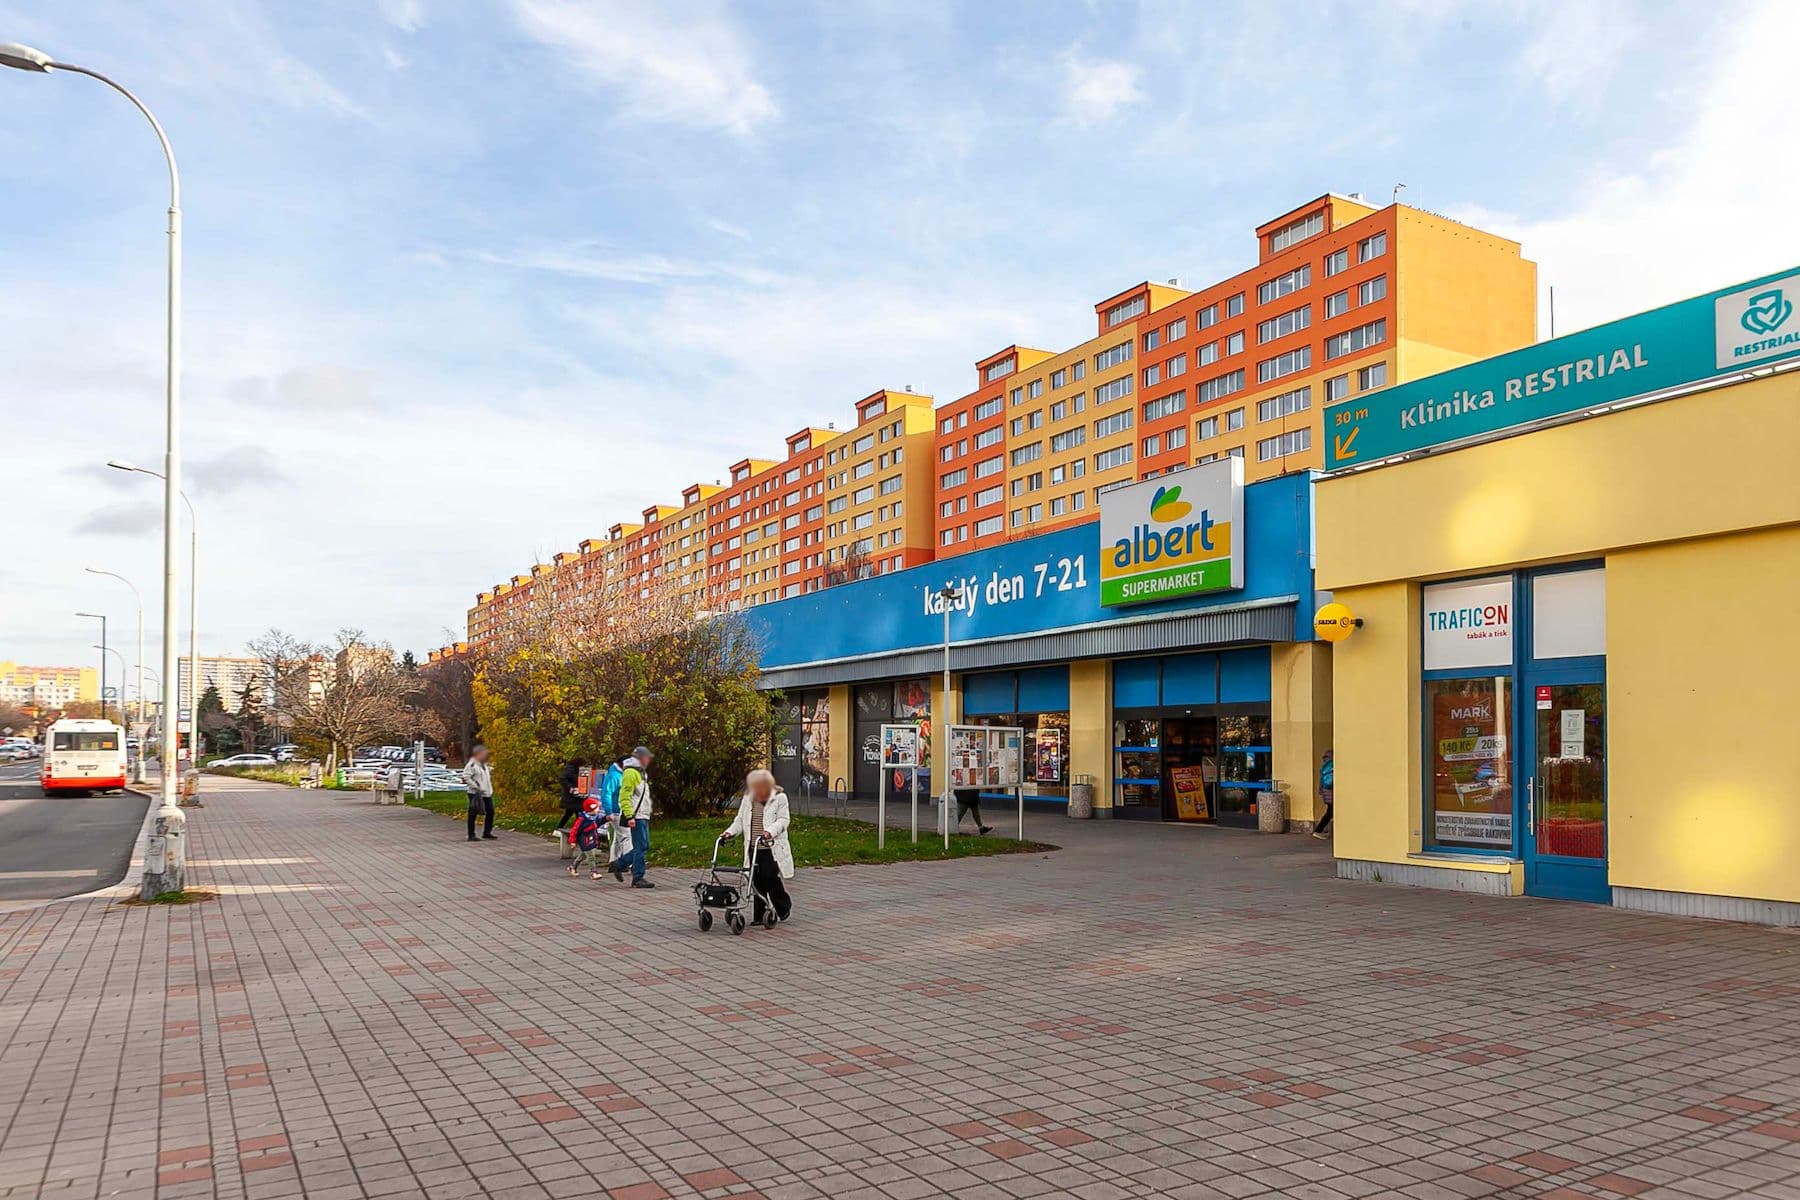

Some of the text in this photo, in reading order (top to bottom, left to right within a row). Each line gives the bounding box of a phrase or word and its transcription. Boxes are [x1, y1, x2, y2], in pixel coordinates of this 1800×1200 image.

[1733, 331, 1800, 357] RESTRIAL
[1400, 343, 1649, 430] Klinika RESTRIAL
[1335, 408, 1369, 427] 30 m
[1114, 509, 1215, 568] albert
[985, 571, 1025, 606] den
[1033, 554, 1088, 598] 7-21
[1121, 570, 1205, 598] SUPERMARKET
[1428, 604, 1508, 631] TRAFICON
[1466, 631, 1487, 640] tabák
[1450, 705, 1490, 719] MARK
[1442, 739, 1472, 753] 140 Kč
